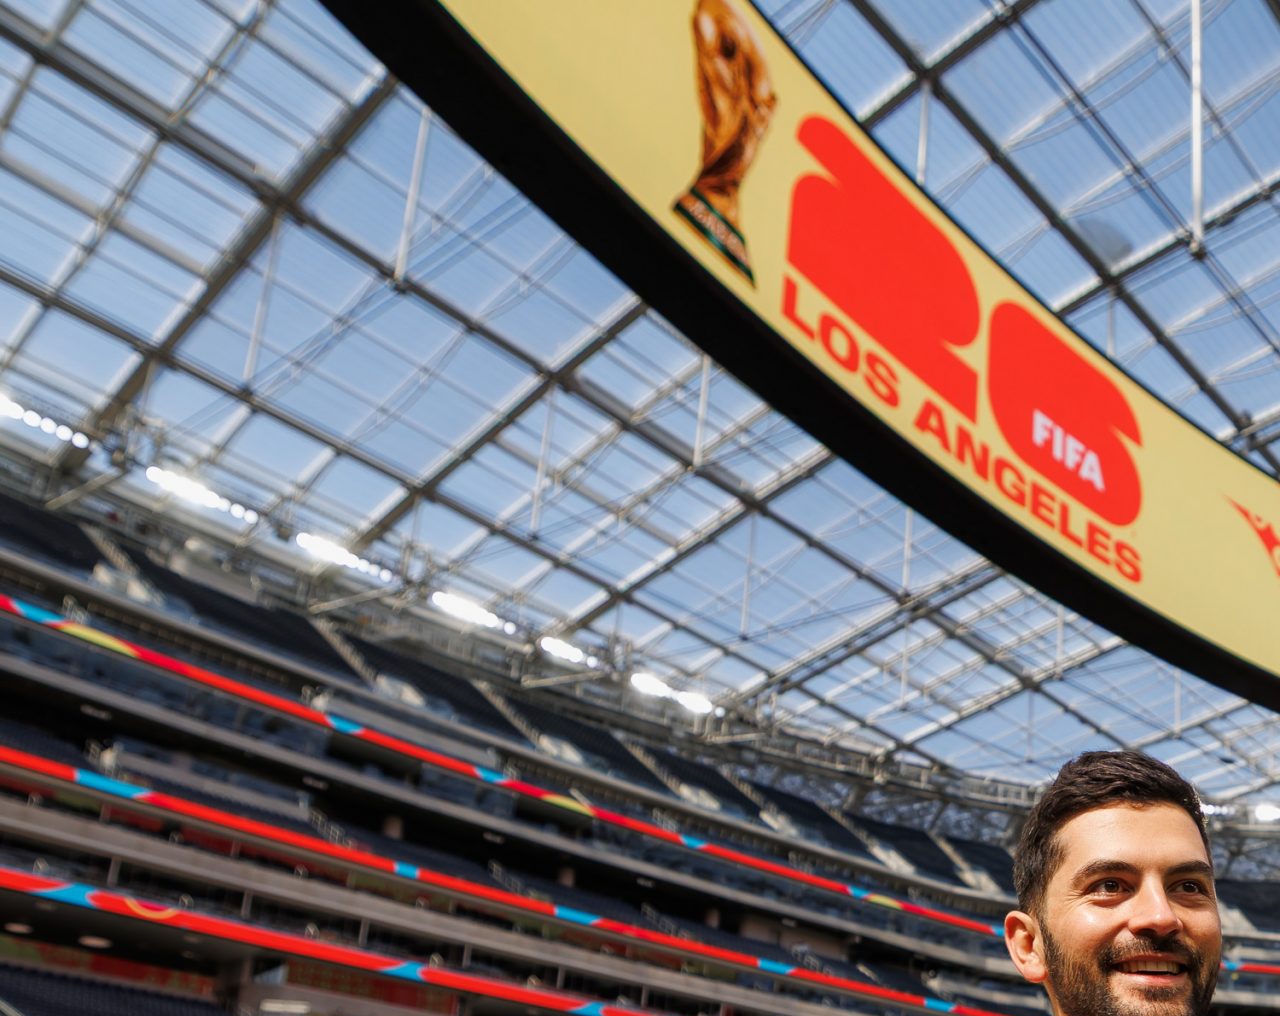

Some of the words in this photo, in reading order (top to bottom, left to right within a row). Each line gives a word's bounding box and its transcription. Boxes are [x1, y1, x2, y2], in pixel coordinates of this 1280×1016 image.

[781, 275, 900, 409] LOS
[913, 399, 1142, 584] ANGELES
[1032, 409, 1105, 491] FIFA
